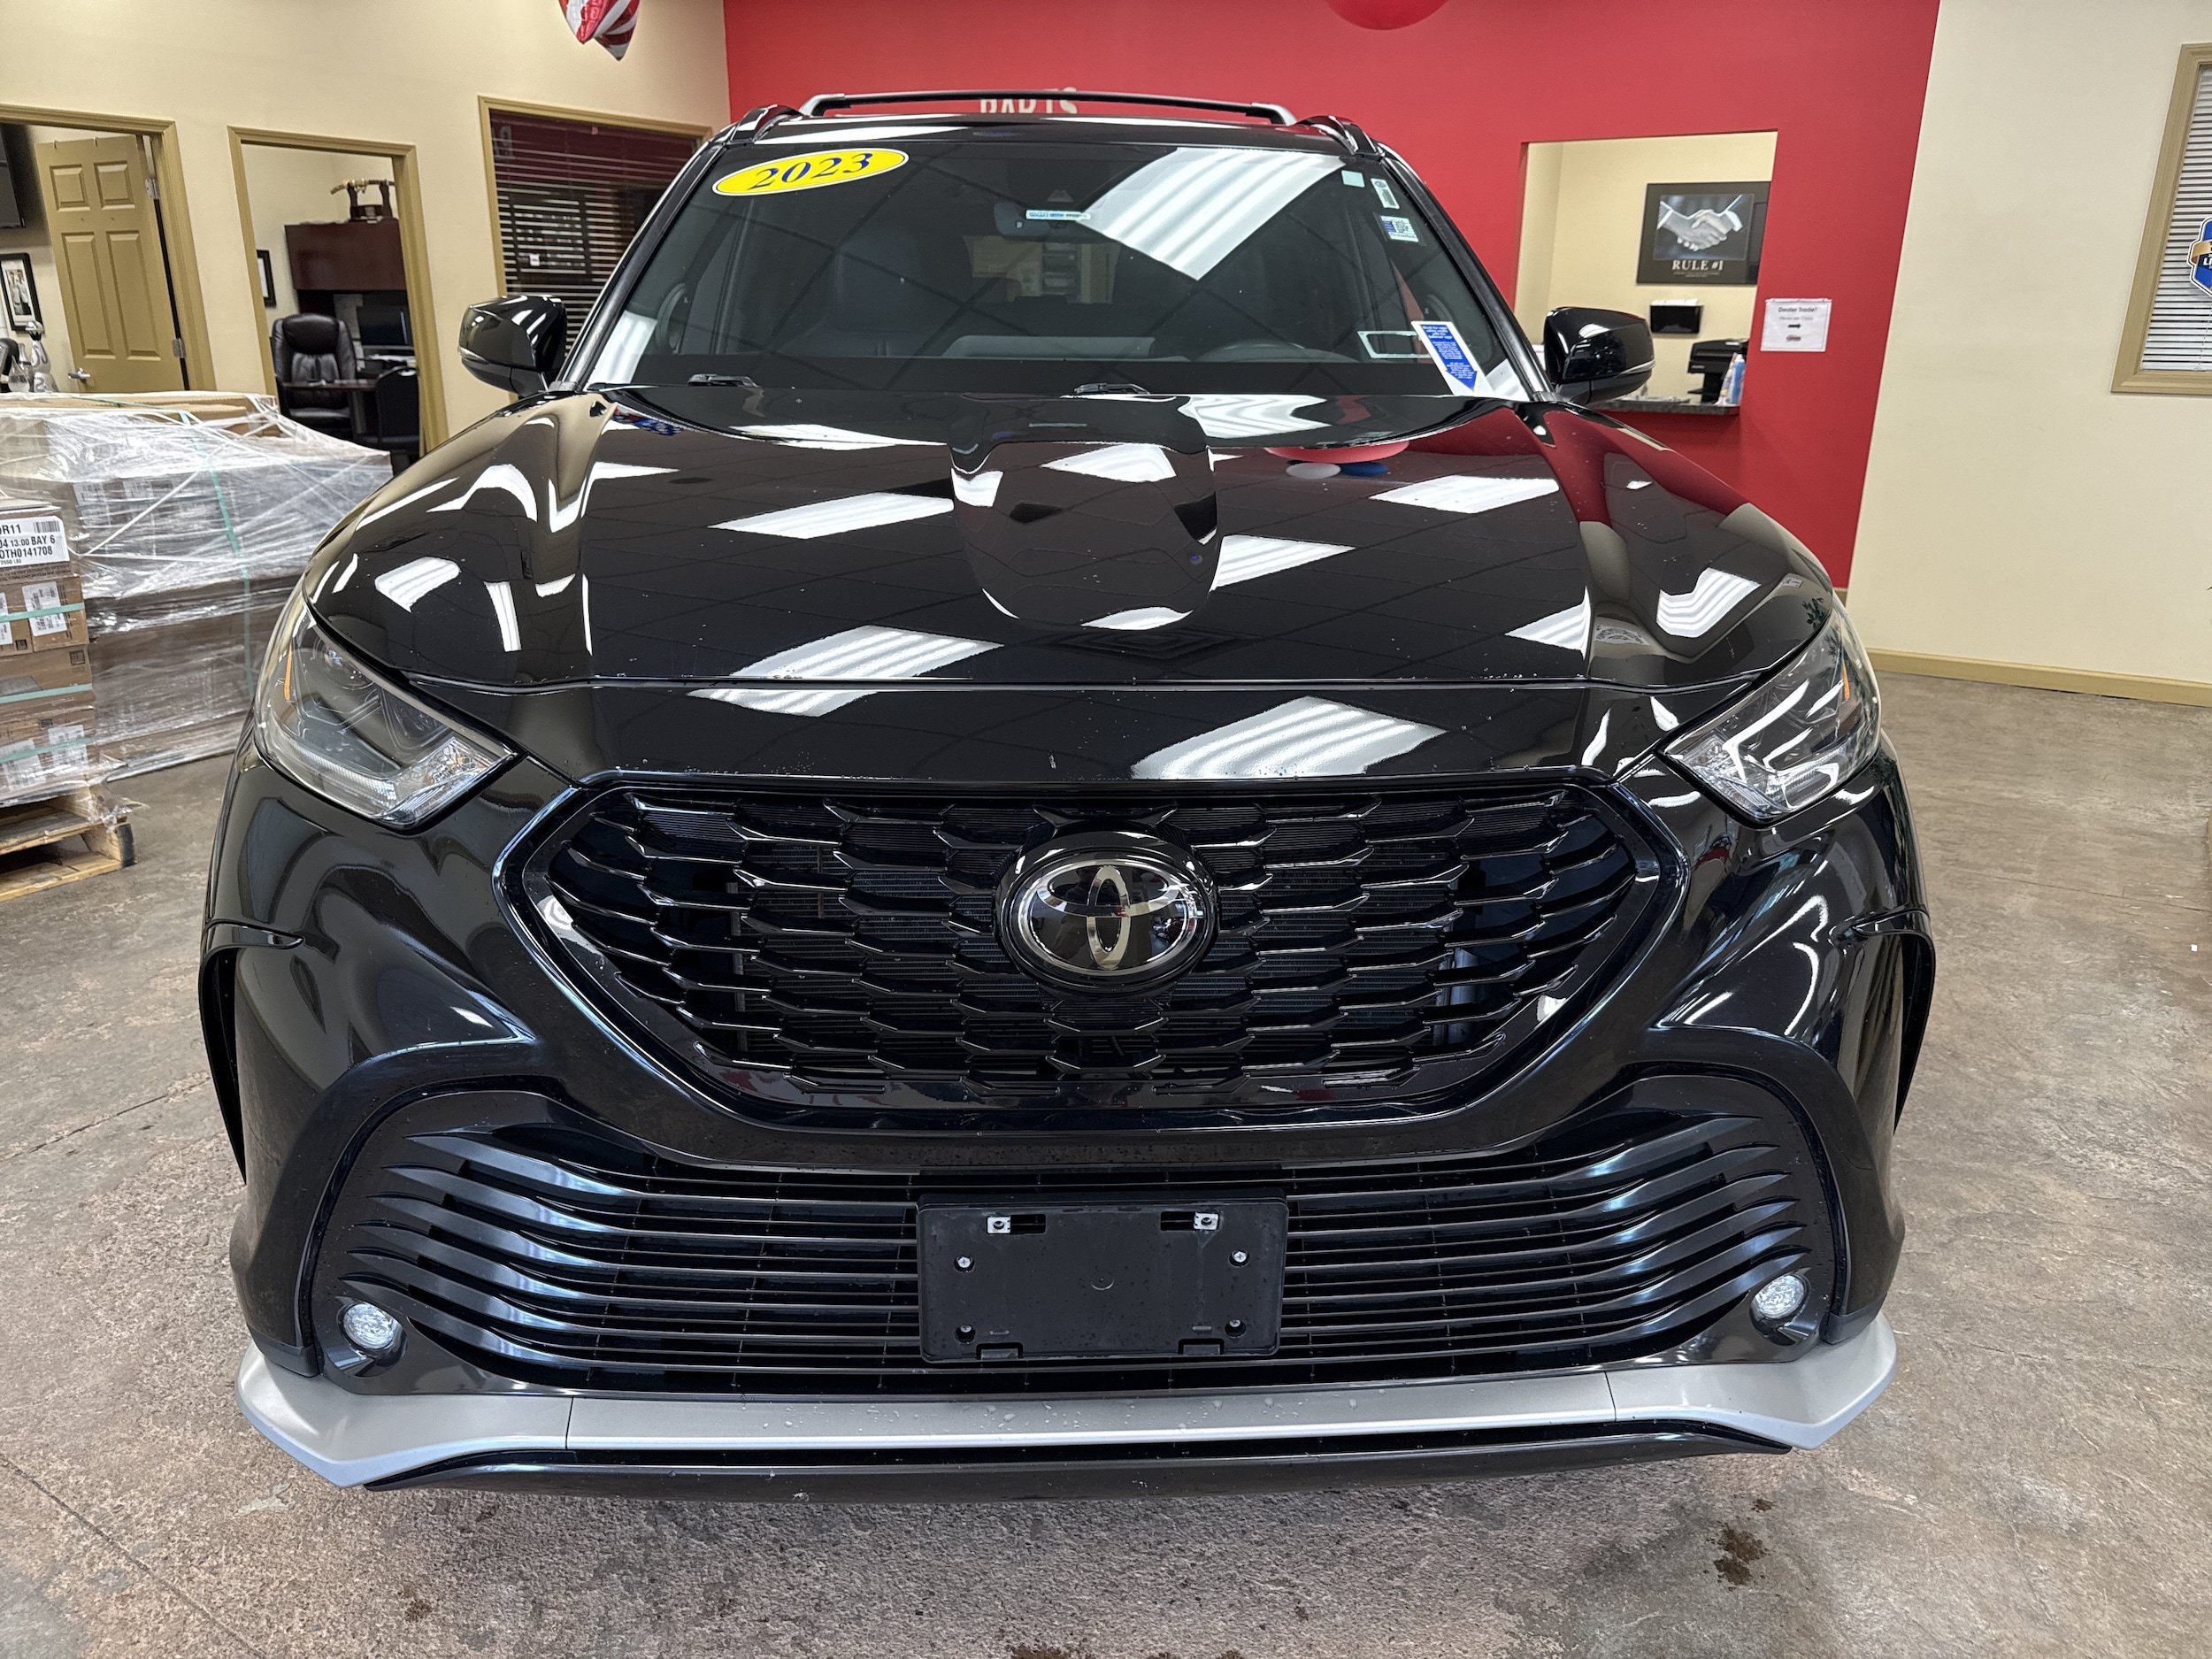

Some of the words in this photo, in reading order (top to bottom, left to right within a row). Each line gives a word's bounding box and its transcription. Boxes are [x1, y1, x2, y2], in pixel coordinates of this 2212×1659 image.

[748, 152, 873, 190] 2023
[1671, 259, 1709, 271] RULE
[1710, 259, 1724, 271] #1
[0, 524, 21, 535] R11
[31, 535, 47, 546] BAY
[50, 534, 56, 544] 6
